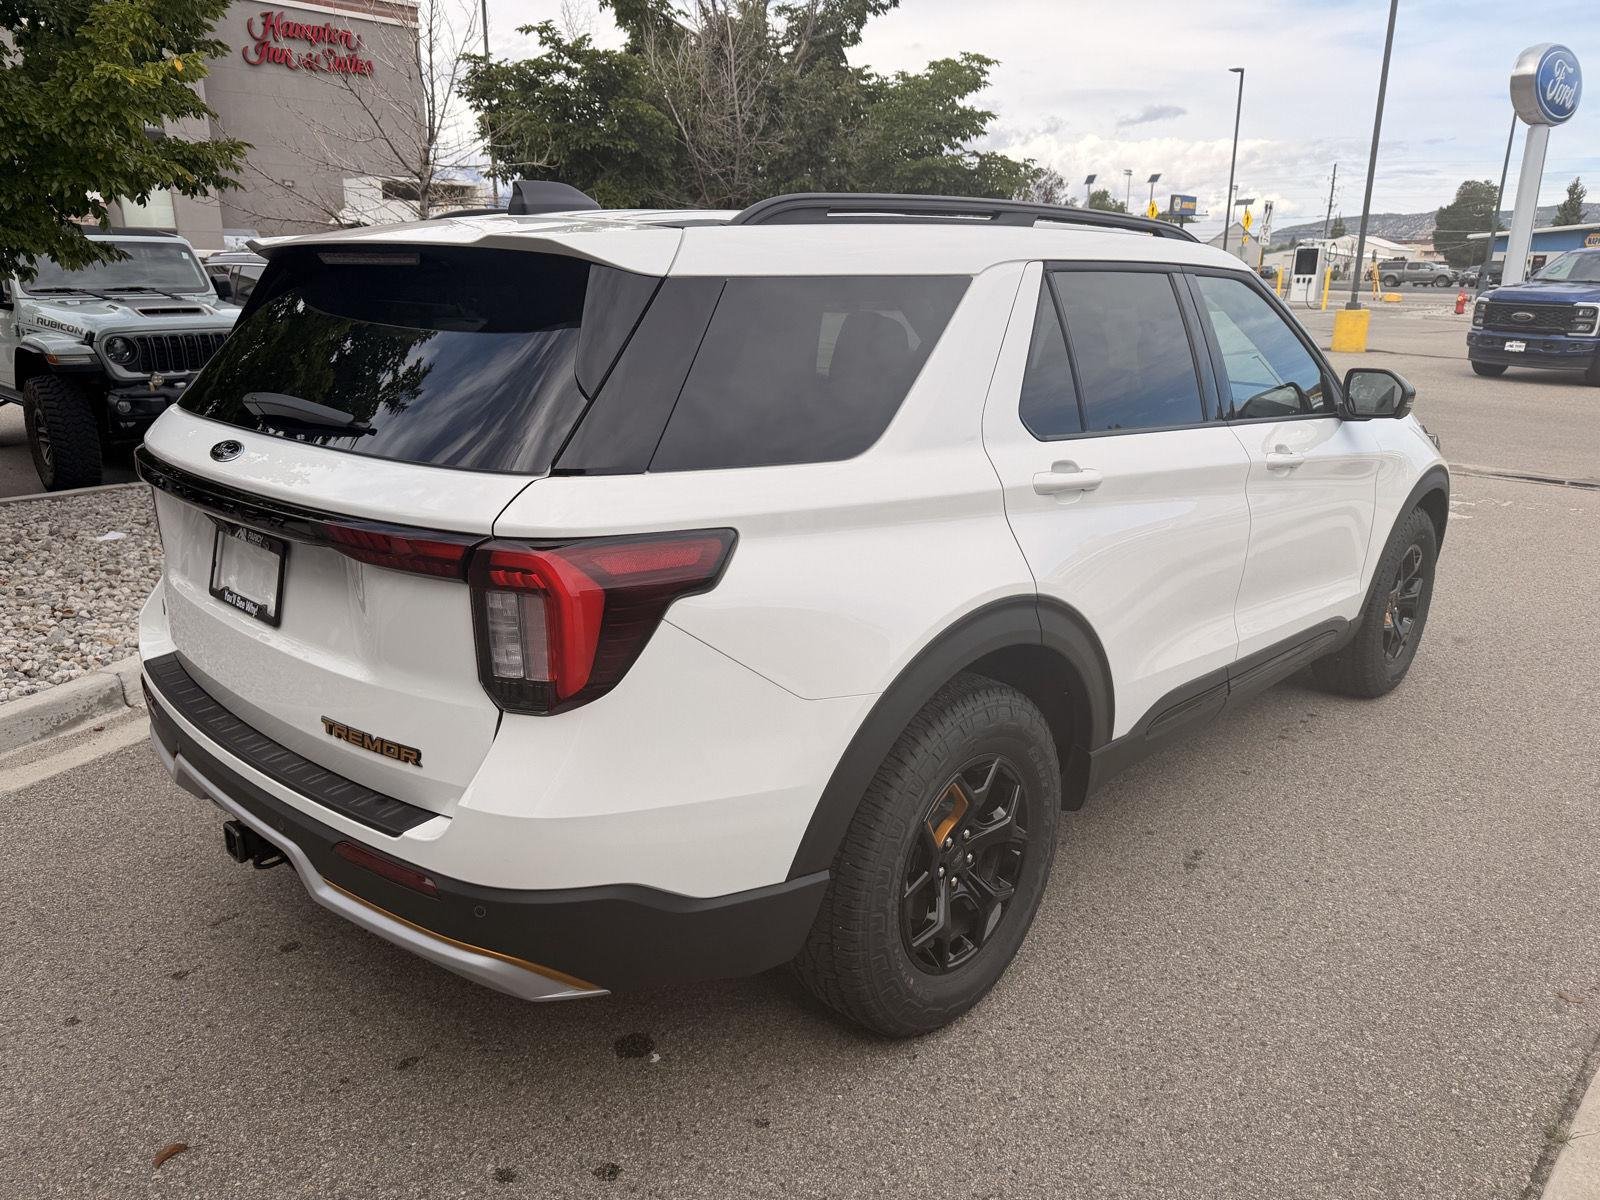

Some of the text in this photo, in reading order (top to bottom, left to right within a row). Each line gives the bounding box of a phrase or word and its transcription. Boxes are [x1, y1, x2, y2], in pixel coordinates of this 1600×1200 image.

[247, 11, 361, 50] Hampton
[242, 41, 299, 71] Inn
[316, 47, 375, 76] Suites
[1546, 59, 1578, 110] Ford
[36, 317, 84, 336] RUBICON
[236, 596, 246, 610] See
[320, 715, 423, 768] TREMOR
